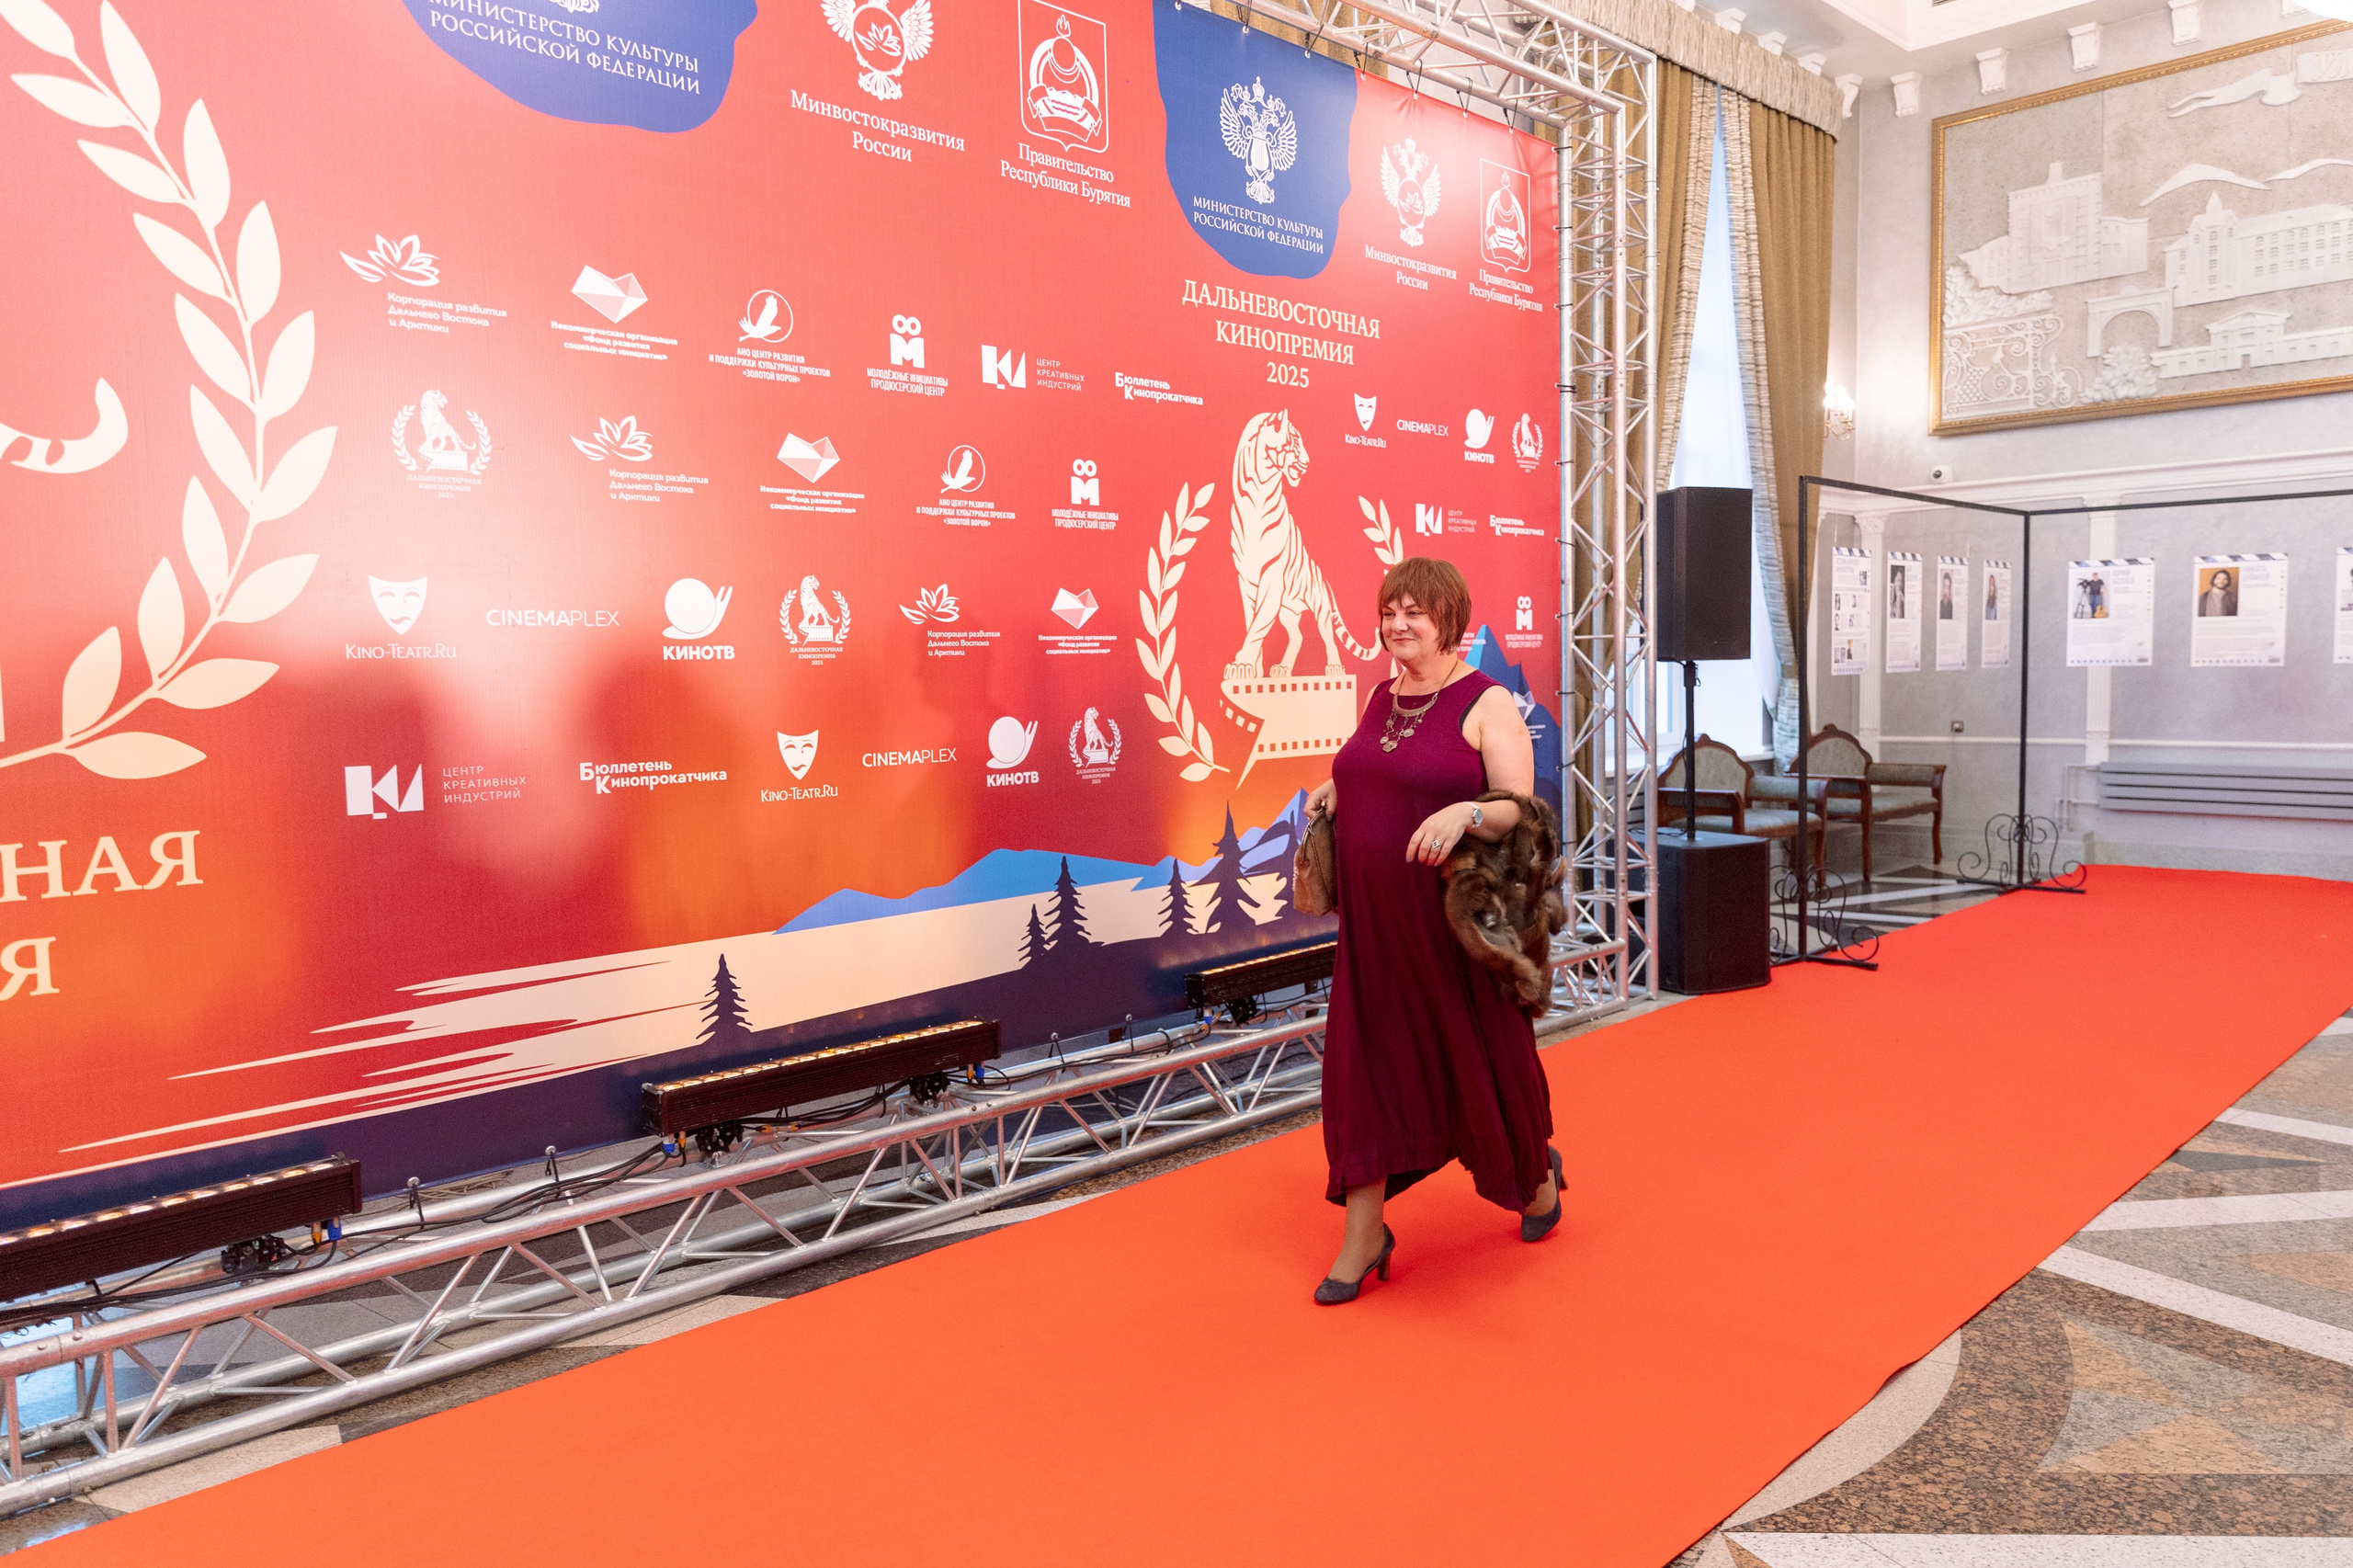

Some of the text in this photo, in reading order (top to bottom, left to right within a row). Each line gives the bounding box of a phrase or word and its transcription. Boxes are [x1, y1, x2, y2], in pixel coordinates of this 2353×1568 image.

[430, 0, 699, 73] ИНИСТЕРСТВО КУЛЬТУРЫ
[431, 11, 699, 94] РОССИЙСКОЙ ФЕДЕРАЦИИ
[791, 91, 964, 152] Минвостокразвития
[853, 131, 912, 162] России
[1018, 143, 1114, 182] Правительство
[1001, 161, 1131, 208] Республики Бурятия
[1193, 196, 1323, 240] МИНИСТЕРСТВО КУЛЬТУРЫ
[1194, 212, 1324, 254] РОССИЙСКОЙ ФЕДЕРАЦИИ
[1365, 244, 1457, 280] Минвостокразвития
[1396, 272, 1428, 291] России
[1479, 269, 1533, 294] Правительство
[387, 292, 507, 318] Корпорация развития
[1469, 282, 1543, 312] Республики Бурятия
[388, 306, 490, 327] Дальнего Востока
[1182, 281, 1380, 339] ДАЛЬНЕВОСТОЧНАЯ
[388, 318, 449, 333] и Арктики
[551, 322, 678, 346] Некоммерческая организация
[563, 343, 668, 360] социальных инициатив»
[612, 339, 651, 350] развития
[1217, 322, 1353, 365] КИНОПРЕМИЯ
[736, 347, 805, 364] АНО ЦЕНТР РАЗВИТИЯ
[1036, 358, 1061, 369] ЦЕНТР
[709, 354, 831, 377] И ПОДДЕРЖКИ КУЛЬТУРНЫХ ПРОЕКТОВ
[743, 369, 801, 383] «ЗОЛОТОЙ ВОРОН»
[867, 369, 949, 387] МОЛОДЁЖНЫЕ ИНИЦИАТИВЫ
[1037, 369, 1085, 381] КРЕАТИВНЫХ
[1115, 372, 1171, 391] Бюллетень
[1267, 362, 1309, 388] 2025
[870, 380, 945, 397] ПРОДЮСЕРСКИЙ ЦЕНТР
[1037, 380, 1081, 392] ИНДУСТРИЙ
[1124, 384, 1204, 405] Кинопрокатчика
[1396, 419, 1449, 437] CINEMAPLEX
[1464, 450, 1495, 464] КИНОТВ
[406, 473, 483, 485] ДАЛЬНЕВОСТОЧНАЯ
[609, 470, 709, 483] Корпорация развития
[418, 483, 472, 493] КИНОПРЕМИЯ
[609, 481, 694, 494] Дальнего Востока
[822, 491, 865, 499] организация
[619, 492, 661, 503] Арктики
[968, 500, 995, 509] РАЗВИТИЯ
[921, 506, 955, 516] ПОДДЕРЖКИ
[989, 511, 1016, 519] ПРОЕКТОВ
[486, 609, 620, 627] CINEMAPLEX
[927, 631, 1001, 640] Корпорация развития
[927, 640, 960, 648] Дальнего
[662, 645, 735, 661] КИНОТВ
[934, 649, 965, 658] Арктики
[861, 747, 958, 768] CINEMAPLEX
[443, 765, 484, 779] ЦЕНТР
[579, 758, 673, 781] Бюллетень
[443, 777, 527, 790] КРЕАТИВНЫХ
[595, 768, 728, 795] Кинопрокатчика
[986, 771, 1040, 788] КИНОТВ
[444, 787, 522, 804] ИНДУСТРИЙ
[0, 830, 204, 903] НАЯ
[0, 937, 60, 1001] Я
